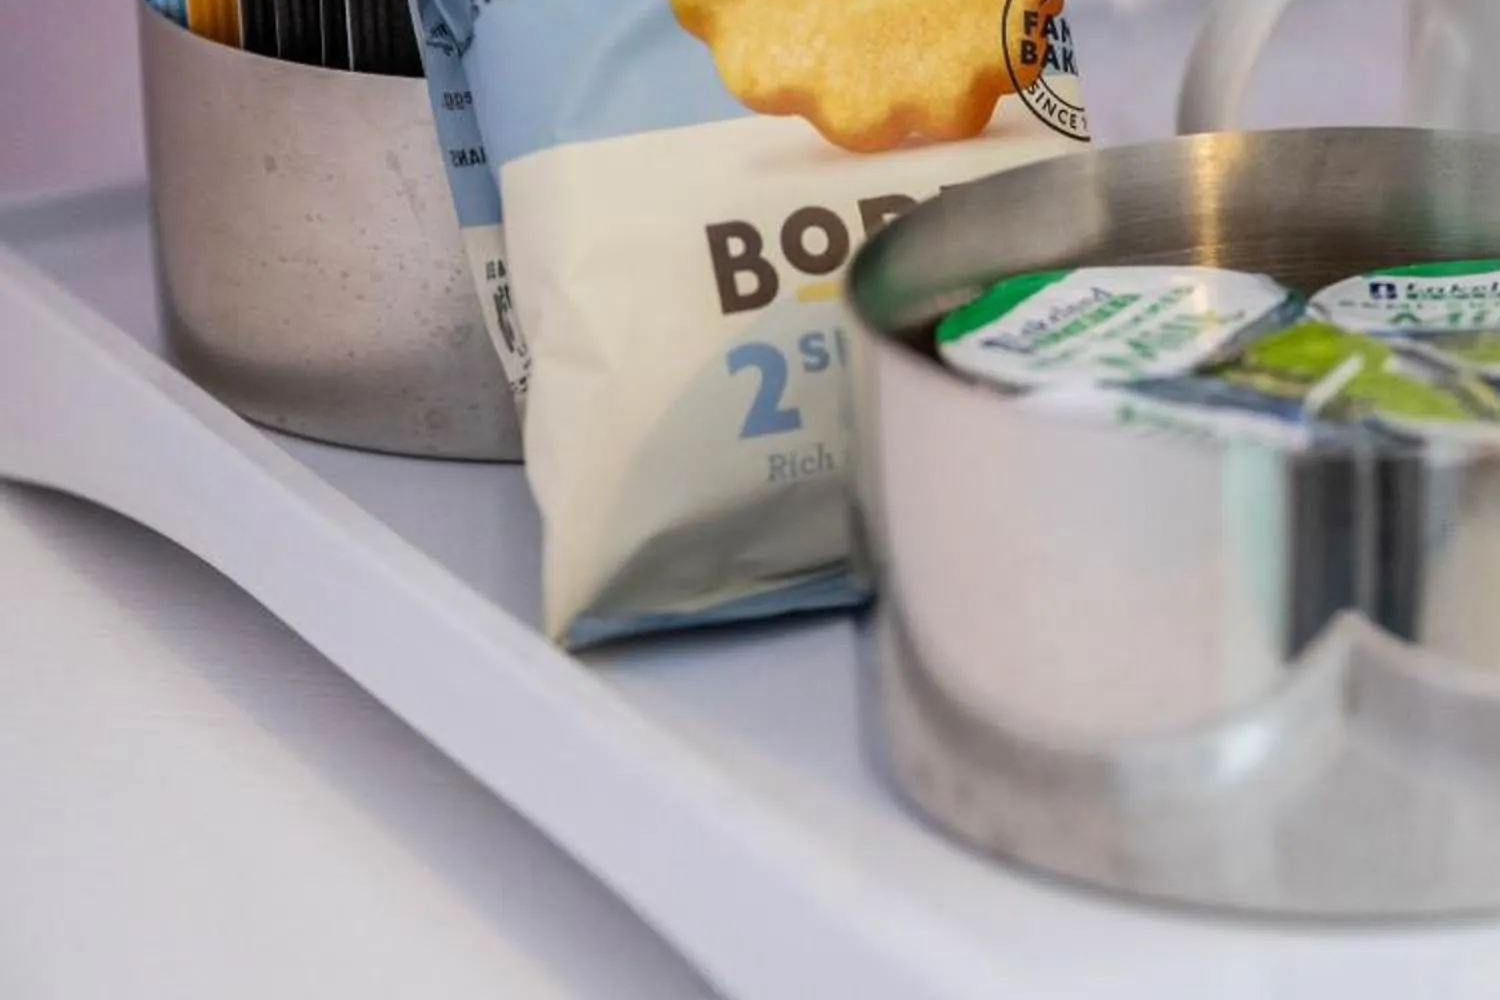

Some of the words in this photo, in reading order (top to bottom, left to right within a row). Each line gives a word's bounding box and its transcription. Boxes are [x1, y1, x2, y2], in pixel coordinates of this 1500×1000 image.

[1023, 9, 1073, 42] FAM
[1020, 40, 1079, 77] BAK
[1026, 81, 1078, 130] SINCE
[725, 342, 803, 440] 2
[767, 443, 836, 482] Rich
